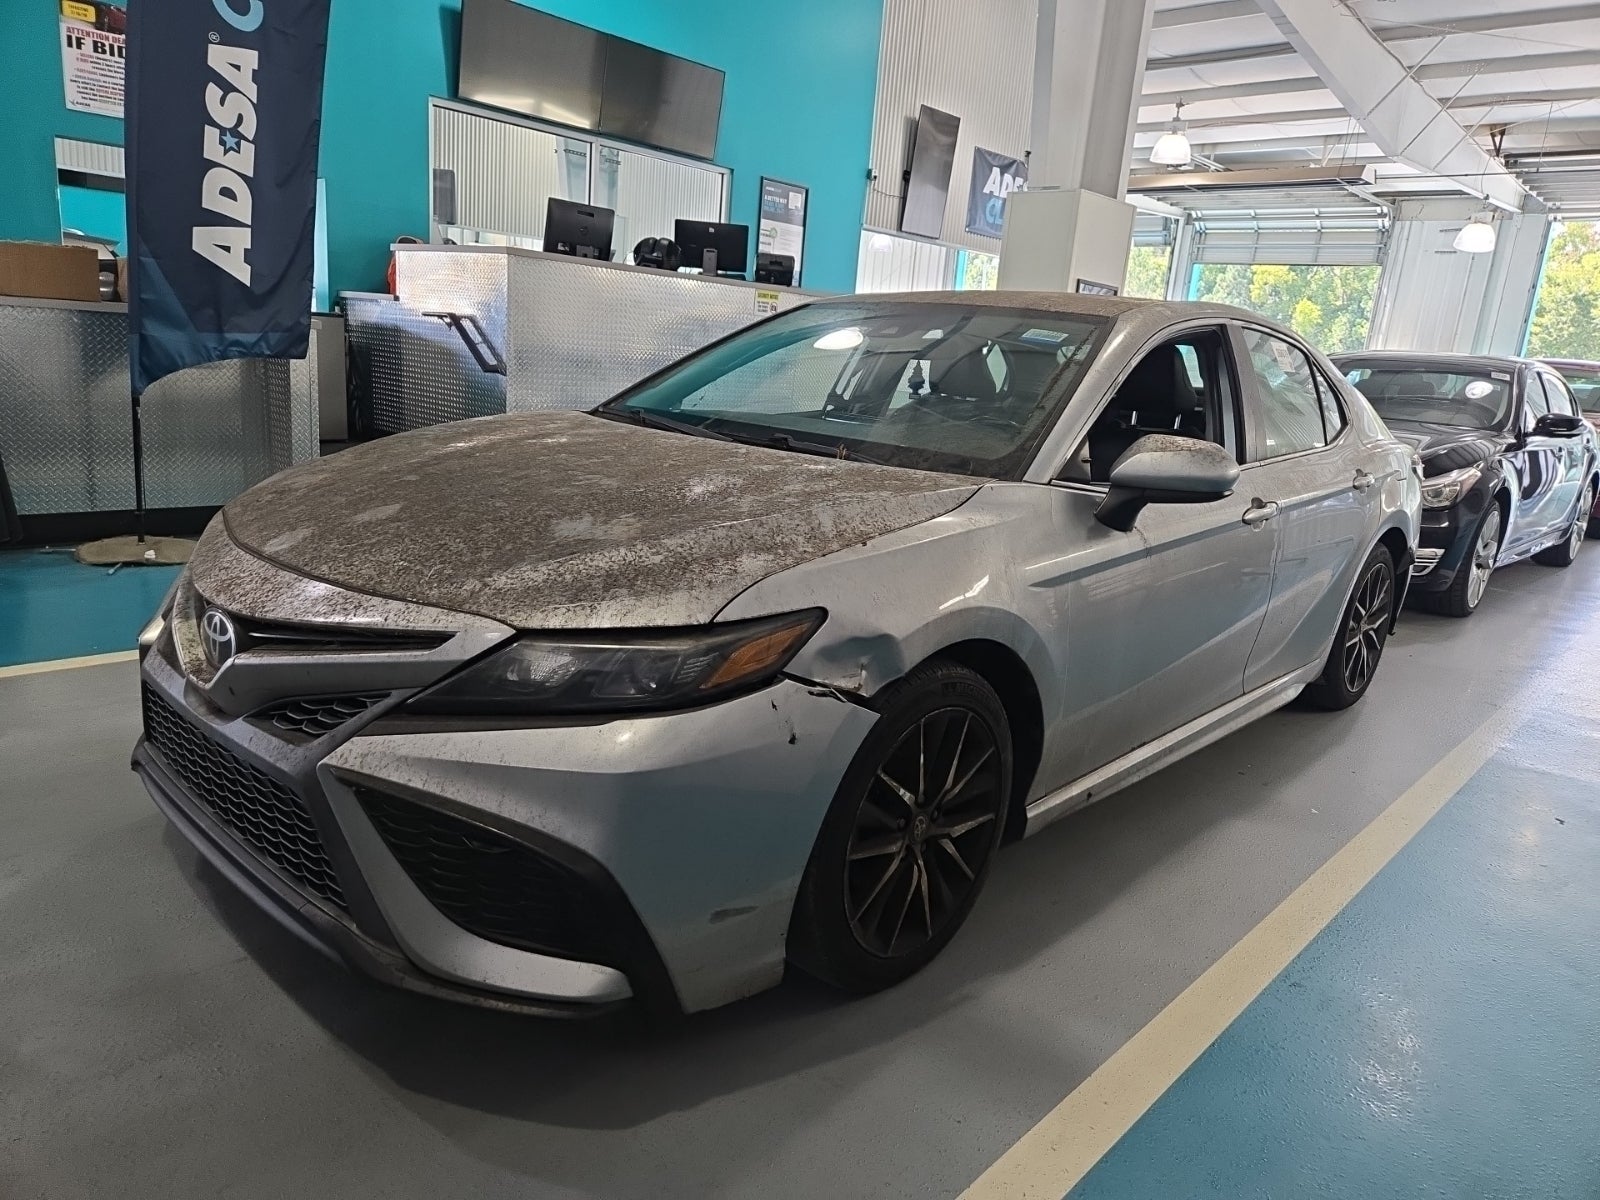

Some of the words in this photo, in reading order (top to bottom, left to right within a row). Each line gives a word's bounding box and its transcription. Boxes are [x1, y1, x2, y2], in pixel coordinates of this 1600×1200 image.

[66, 26, 110, 42] ATTENTION
[66, 34, 86, 50] IF
[192, 43, 259, 287] ADESA
